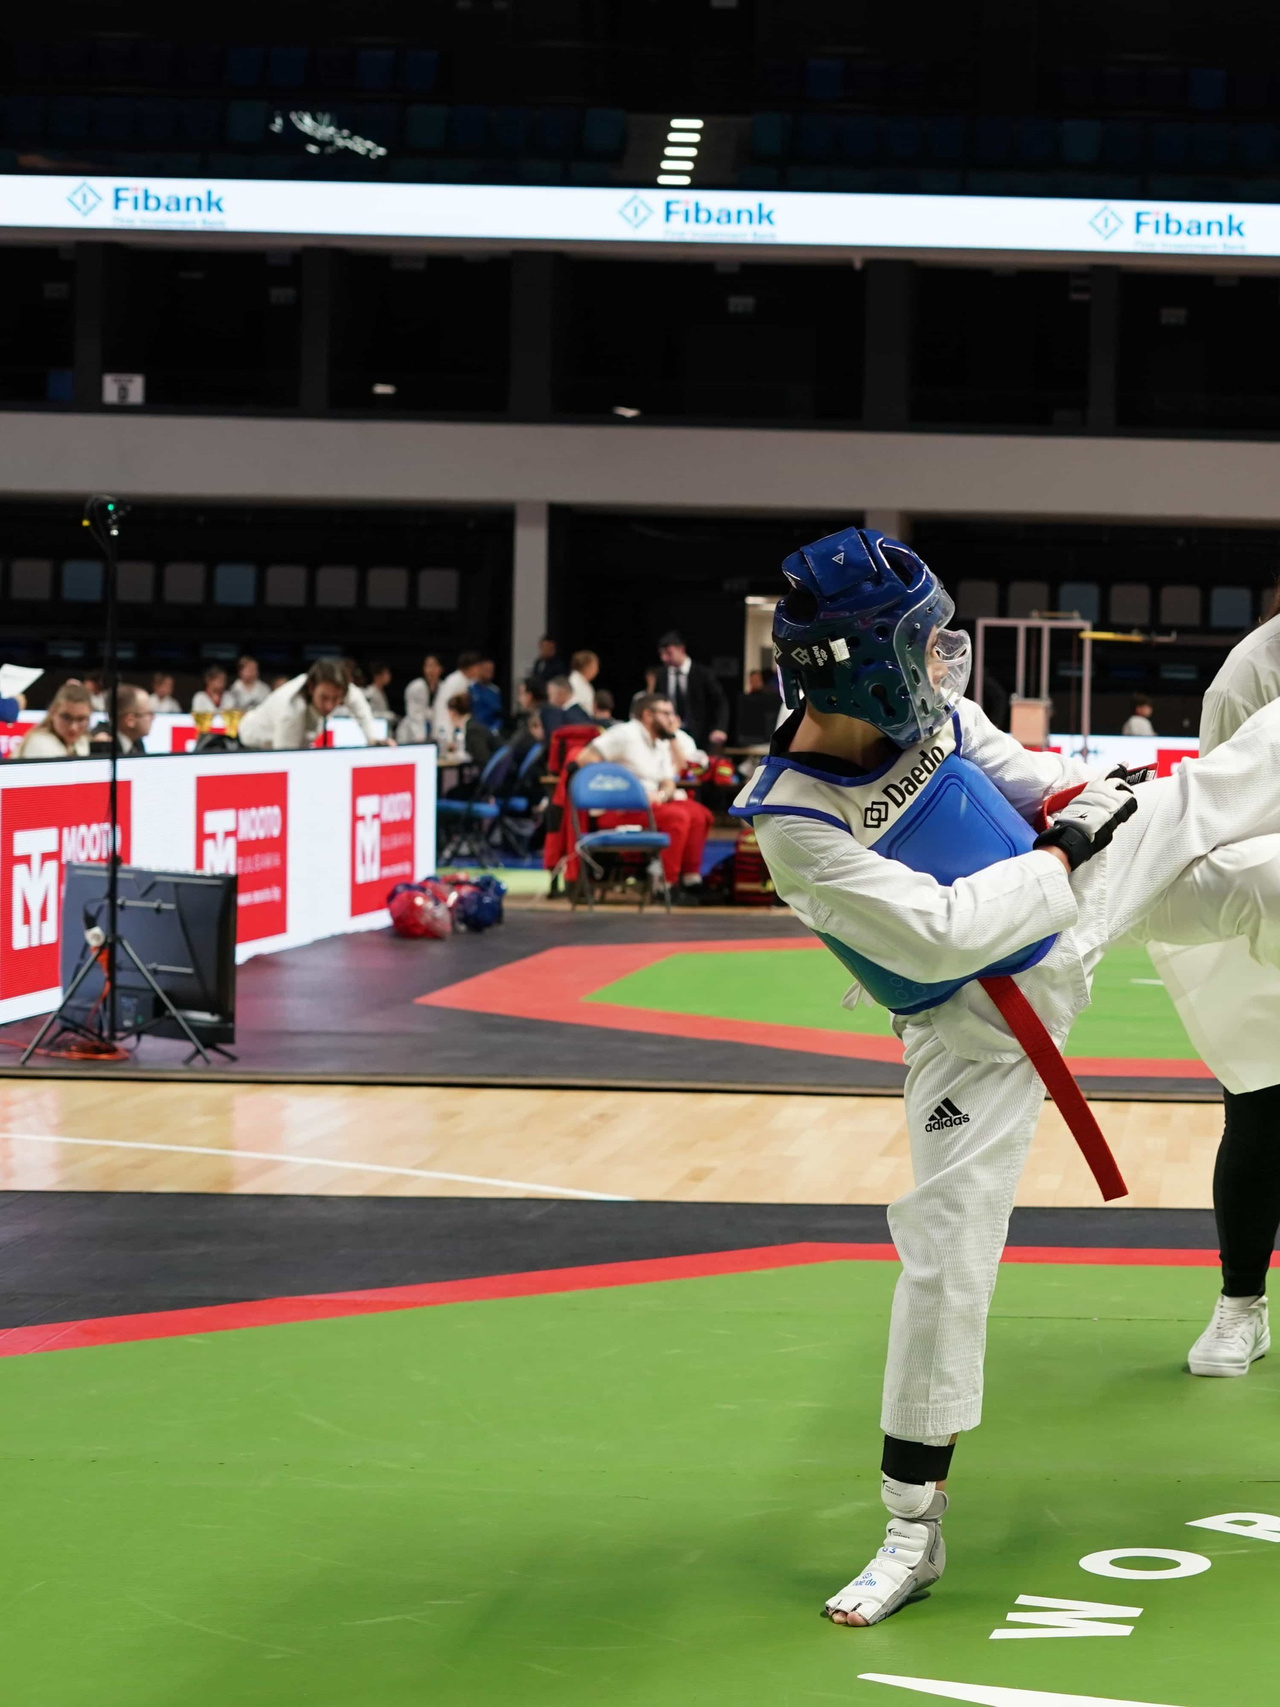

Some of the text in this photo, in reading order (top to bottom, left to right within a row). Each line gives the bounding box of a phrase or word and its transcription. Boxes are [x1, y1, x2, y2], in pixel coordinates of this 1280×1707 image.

[113, 187, 224, 213] Fibank
[664, 200, 775, 226] Fibank
[1135, 211, 1245, 237] Fibank
[881, 745, 945, 809] Daedo
[1126, 768, 1147, 783] PORT
[925, 1113, 970, 1132] adidas
